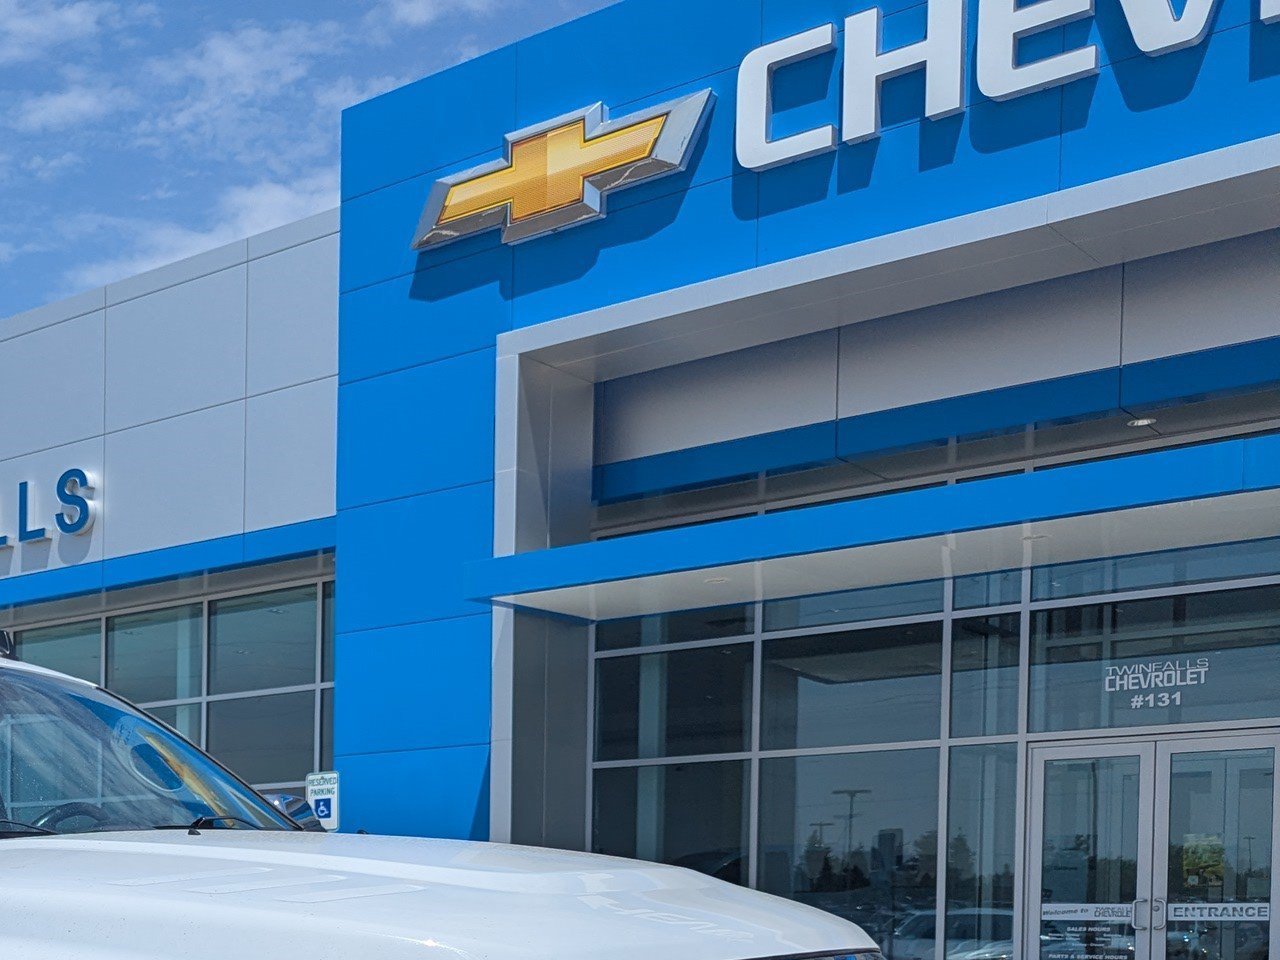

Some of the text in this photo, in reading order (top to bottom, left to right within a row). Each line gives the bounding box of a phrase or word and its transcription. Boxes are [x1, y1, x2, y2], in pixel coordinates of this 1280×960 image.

[735, 0, 1280, 171] CHE
[1105, 657, 1209, 676] TWINFALLS
[1105, 667, 1209, 692] CHEVROLET
[1130, 691, 1181, 709] #131
[308, 776, 338, 787] RESERVED
[310, 787, 336, 797] PARKING
[1042, 908, 1079, 916] Welcome
[1094, 910, 1132, 918] CHEVROLE
[1173, 906, 1269, 917] ENTRANCE
